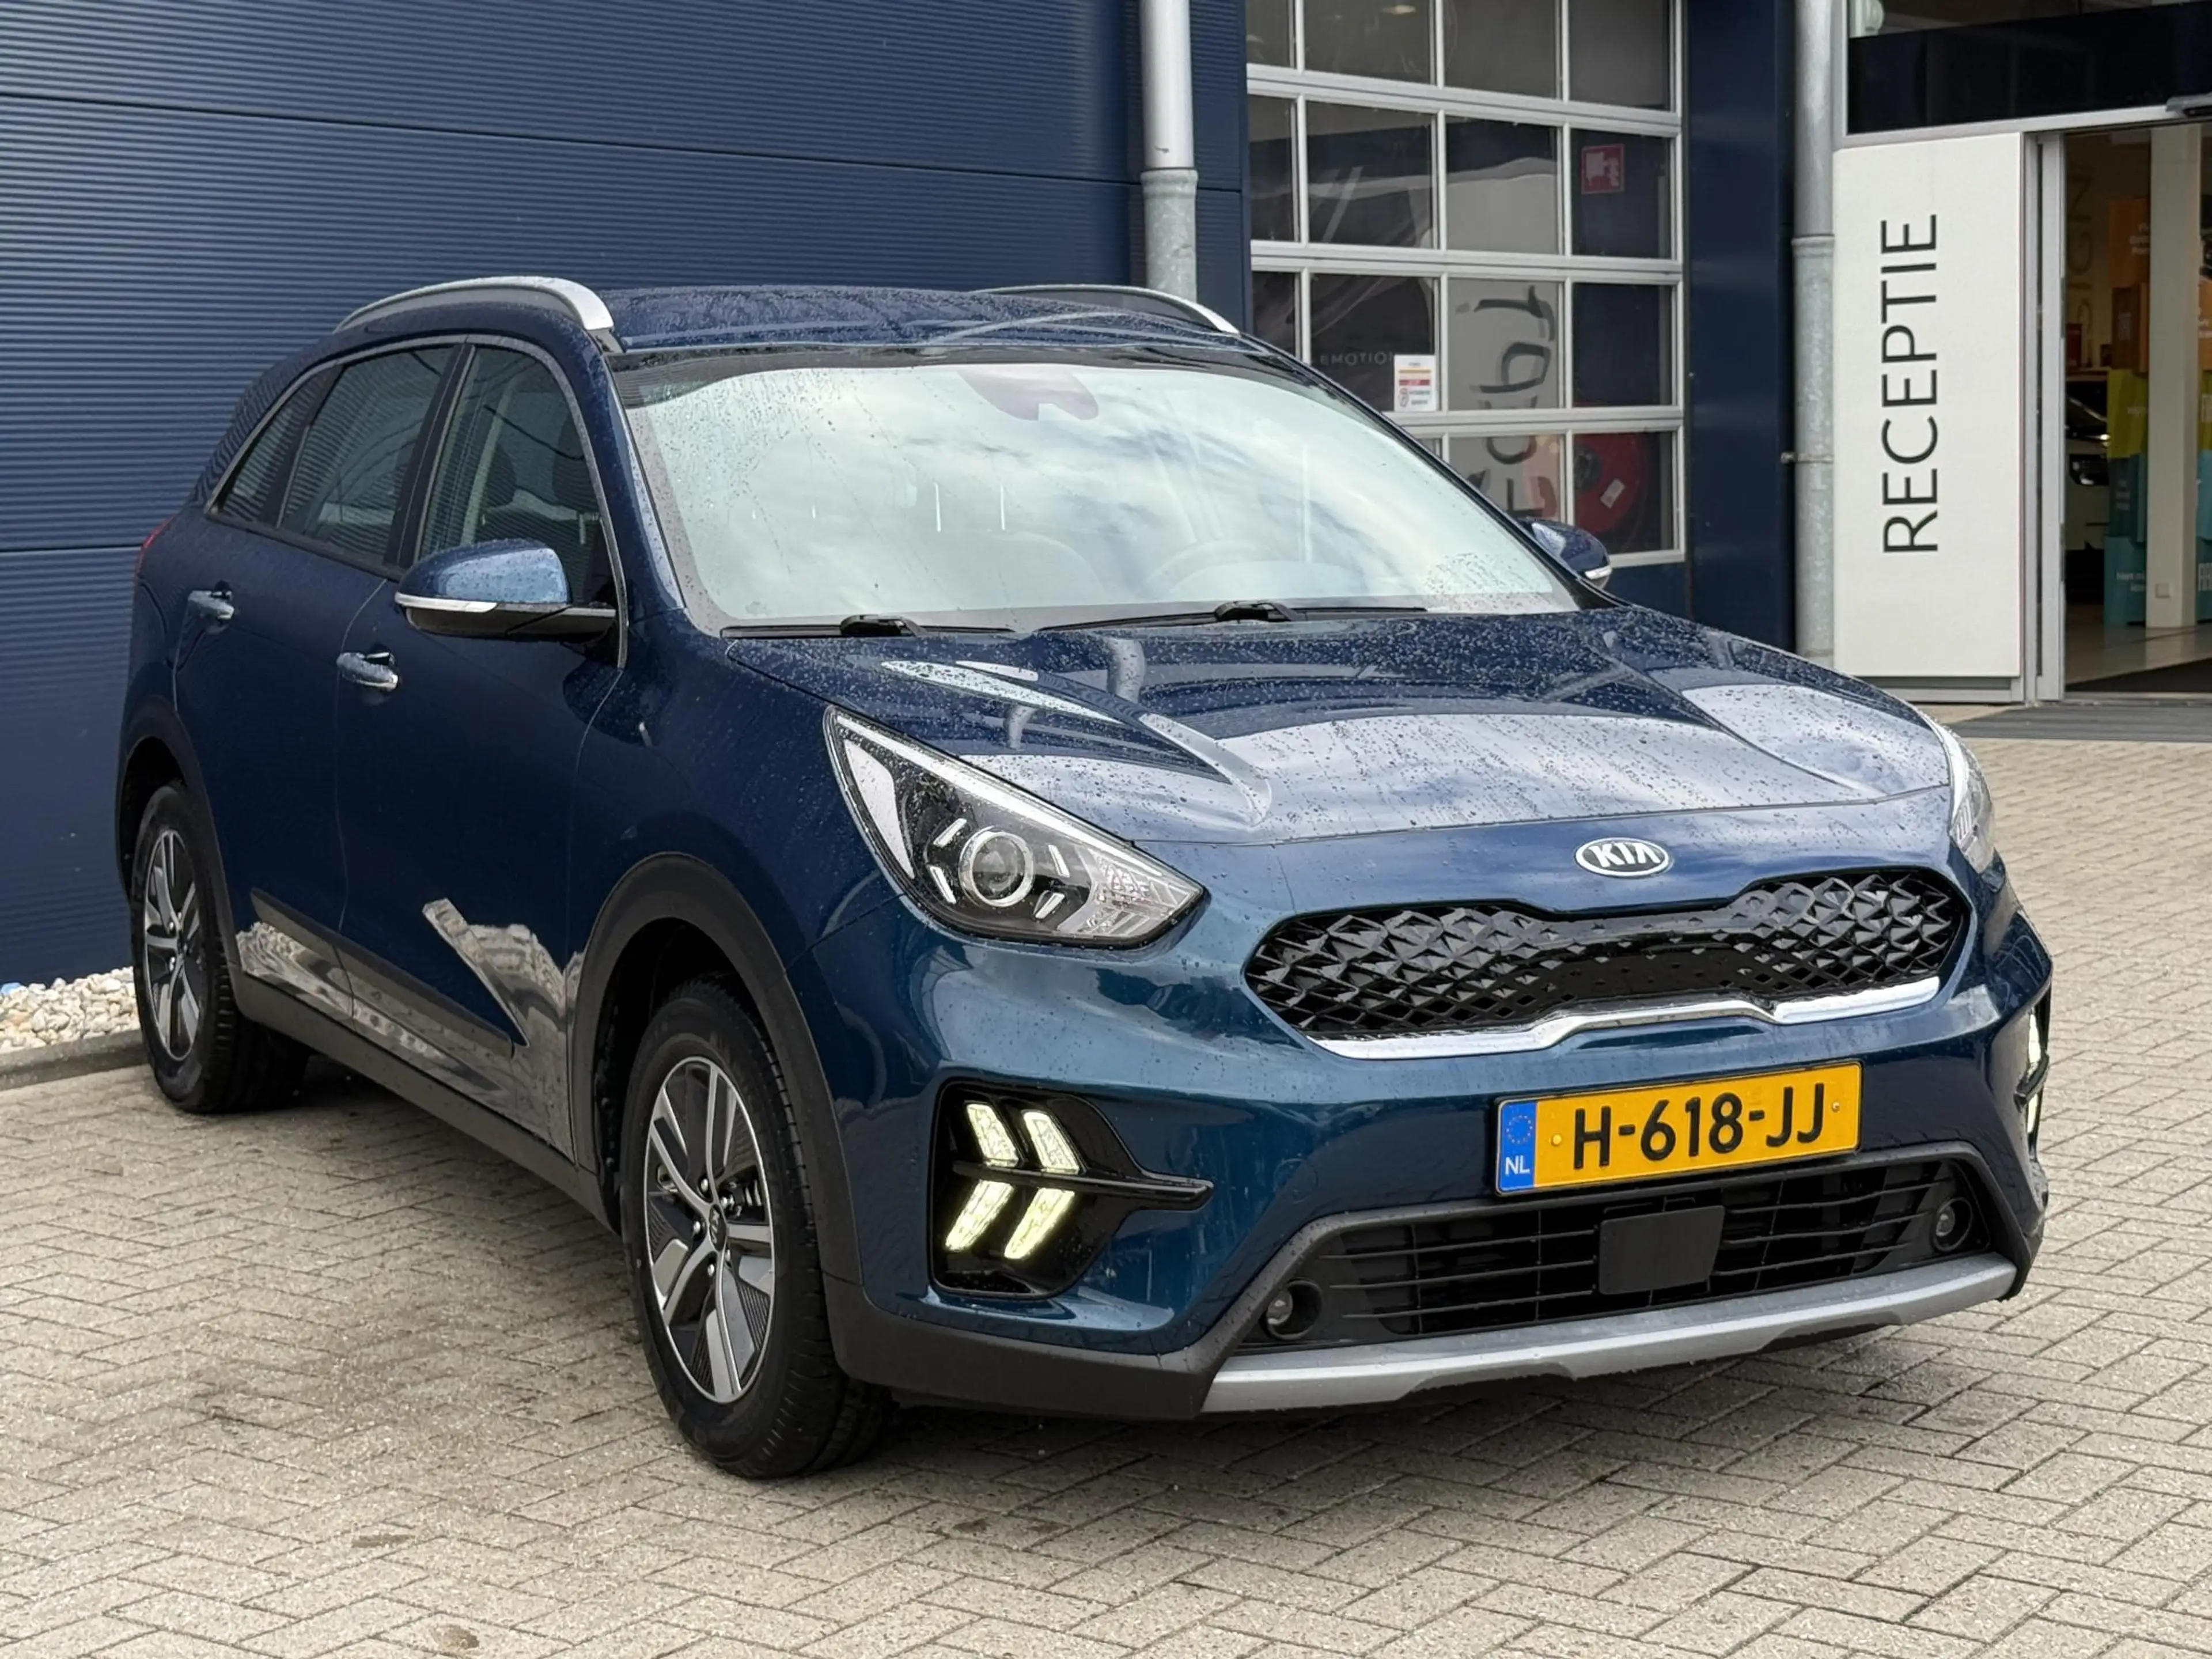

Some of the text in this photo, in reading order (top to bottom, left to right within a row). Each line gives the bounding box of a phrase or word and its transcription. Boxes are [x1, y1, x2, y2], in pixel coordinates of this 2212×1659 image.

[1880, 214, 1938, 554] RECEPTIE
[1588, 841, 1661, 868] KIA
[1573, 1082, 1825, 1170] H-618-JJ
[1505, 1154, 1531, 1175] NL
